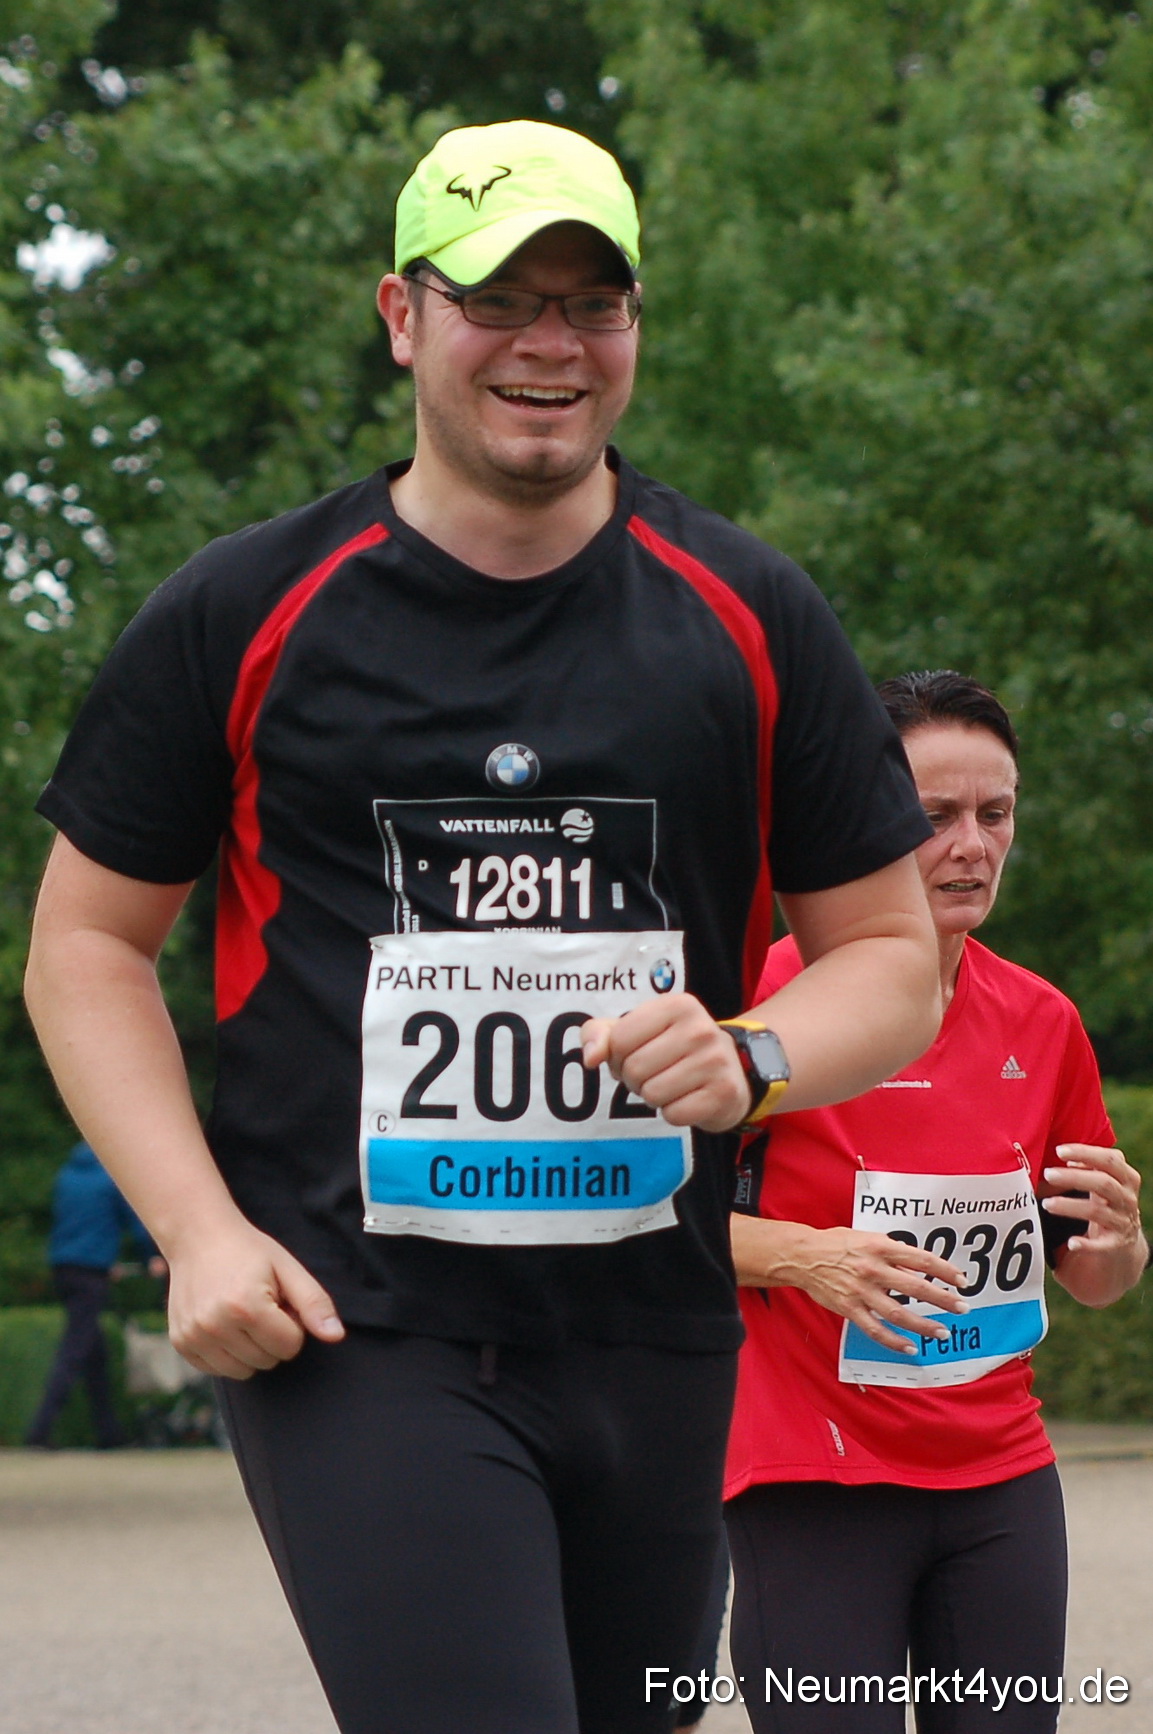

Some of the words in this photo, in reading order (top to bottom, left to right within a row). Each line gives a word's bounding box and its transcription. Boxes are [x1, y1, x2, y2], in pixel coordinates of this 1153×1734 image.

[439, 818, 555, 834] VATTENFALL
[449, 854, 592, 921] 12811
[375, 965, 482, 991] PARTL
[492, 966, 638, 991] Neumarkt
[376, 1114, 388, 1133] C
[429, 1155, 631, 1198] Corbinian
[860, 1194, 935, 1217] PARTL
[940, 1192, 1028, 1216] Neumarkt
